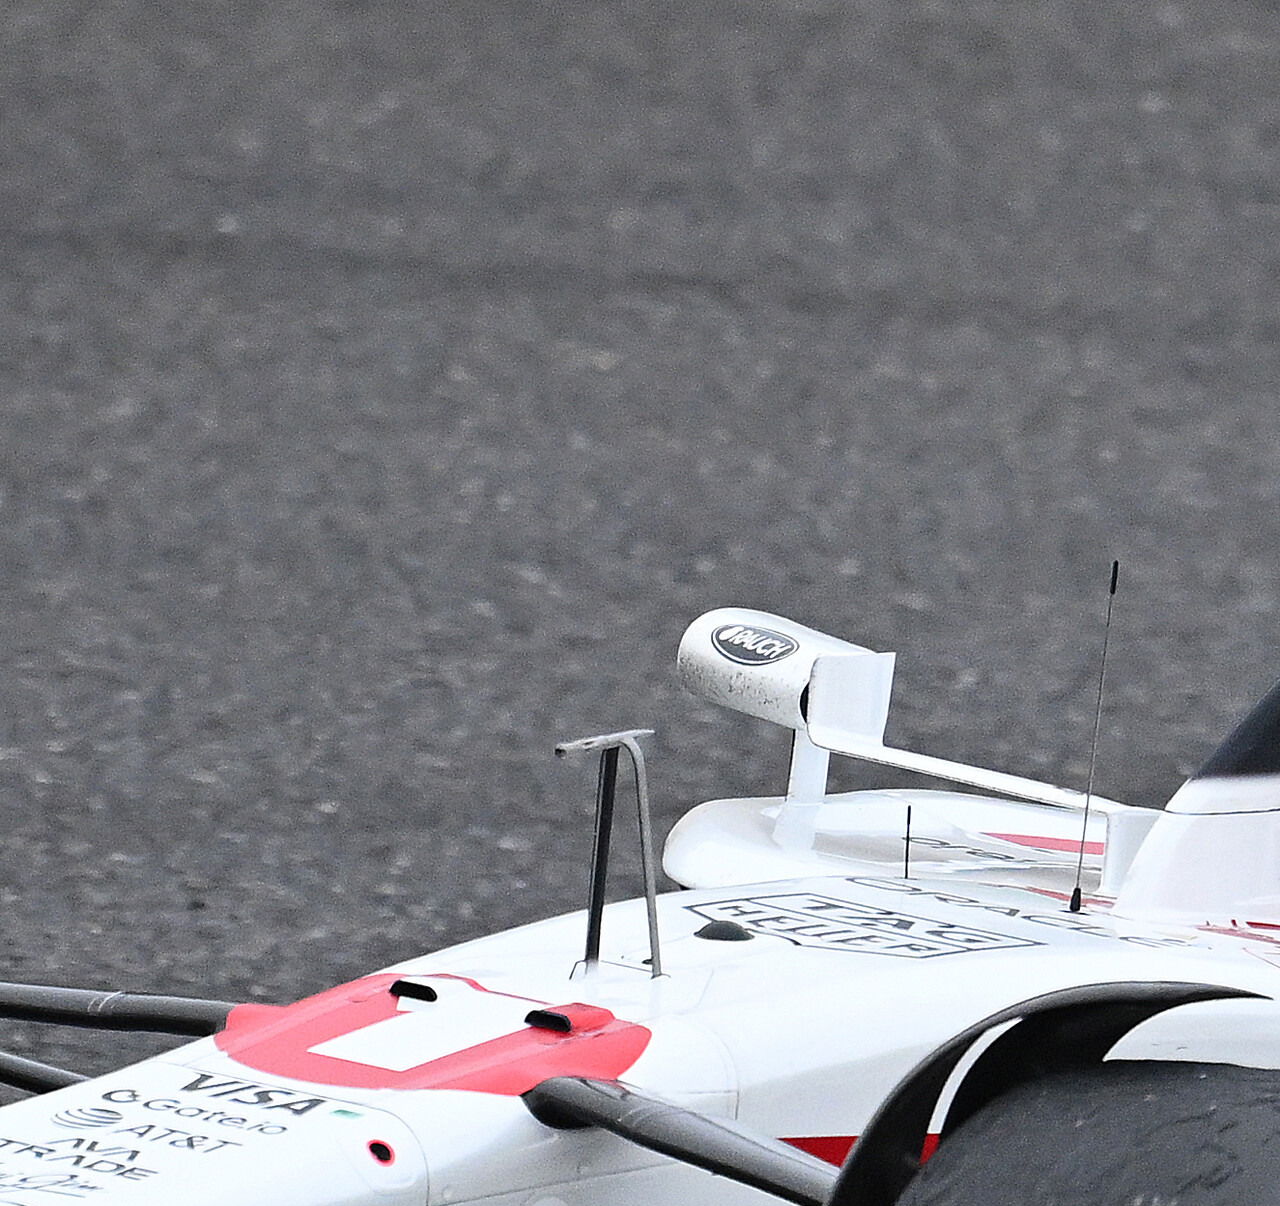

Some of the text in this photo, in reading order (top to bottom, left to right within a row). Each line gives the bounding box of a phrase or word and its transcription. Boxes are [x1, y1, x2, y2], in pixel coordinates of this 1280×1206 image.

[727, 628, 792, 659] RAUCH
[180, 1073, 327, 1116] VISA
[142, 1098, 288, 1135] Gate.io
[112, 1124, 243, 1154] AT&T
[0, 1138, 159, 1181] TRADE
